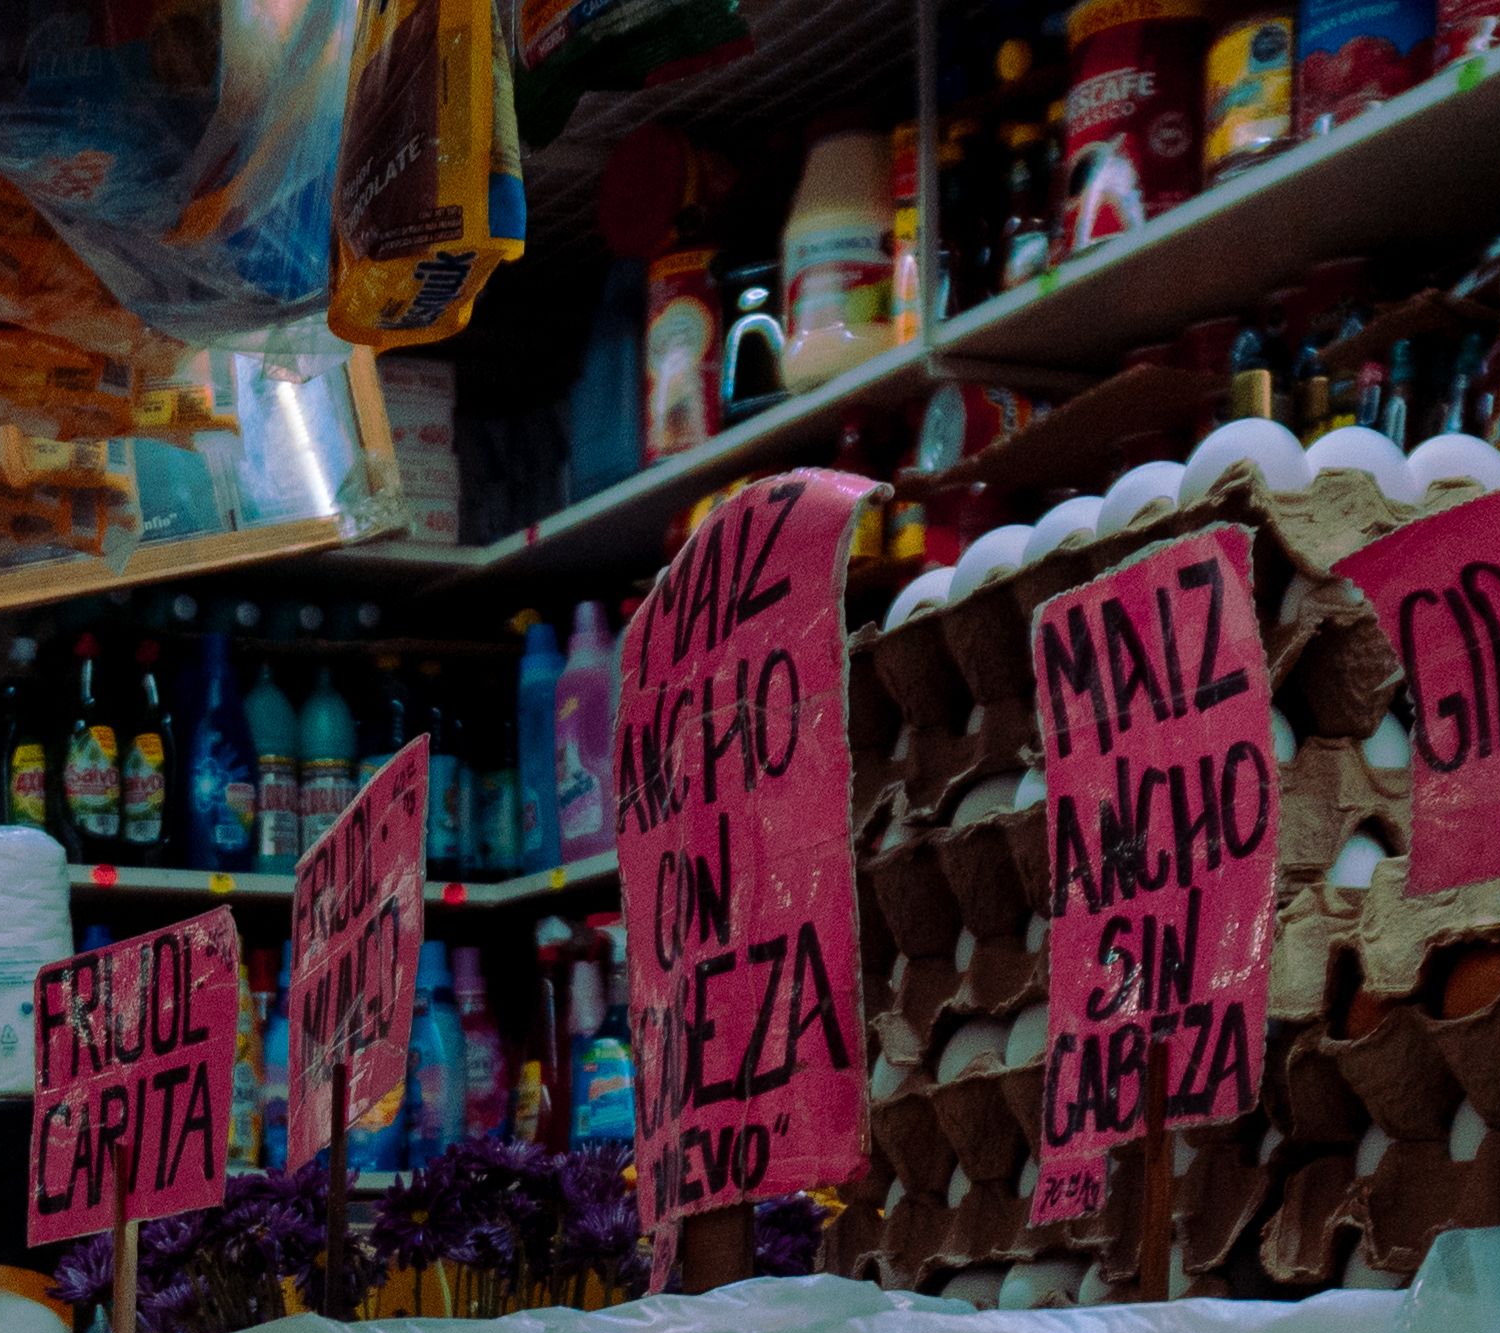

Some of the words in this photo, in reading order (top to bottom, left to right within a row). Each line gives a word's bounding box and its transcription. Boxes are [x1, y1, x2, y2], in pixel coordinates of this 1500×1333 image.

[641, 482, 807, 690] MAIZ
[1042, 557, 1250, 759] MAIZ
[616, 646, 800, 835] ANCHO
[293, 797, 378, 972] FRIJOL
[654, 812, 732, 974] CON
[1053, 741, 1270, 918] ANCHO
[38, 932, 210, 1088] FRIJOL
[638, 921, 851, 1142] CABEZA
[1086, 886, 1202, 1024] SIN
[36, 1060, 216, 1216] CARITA
